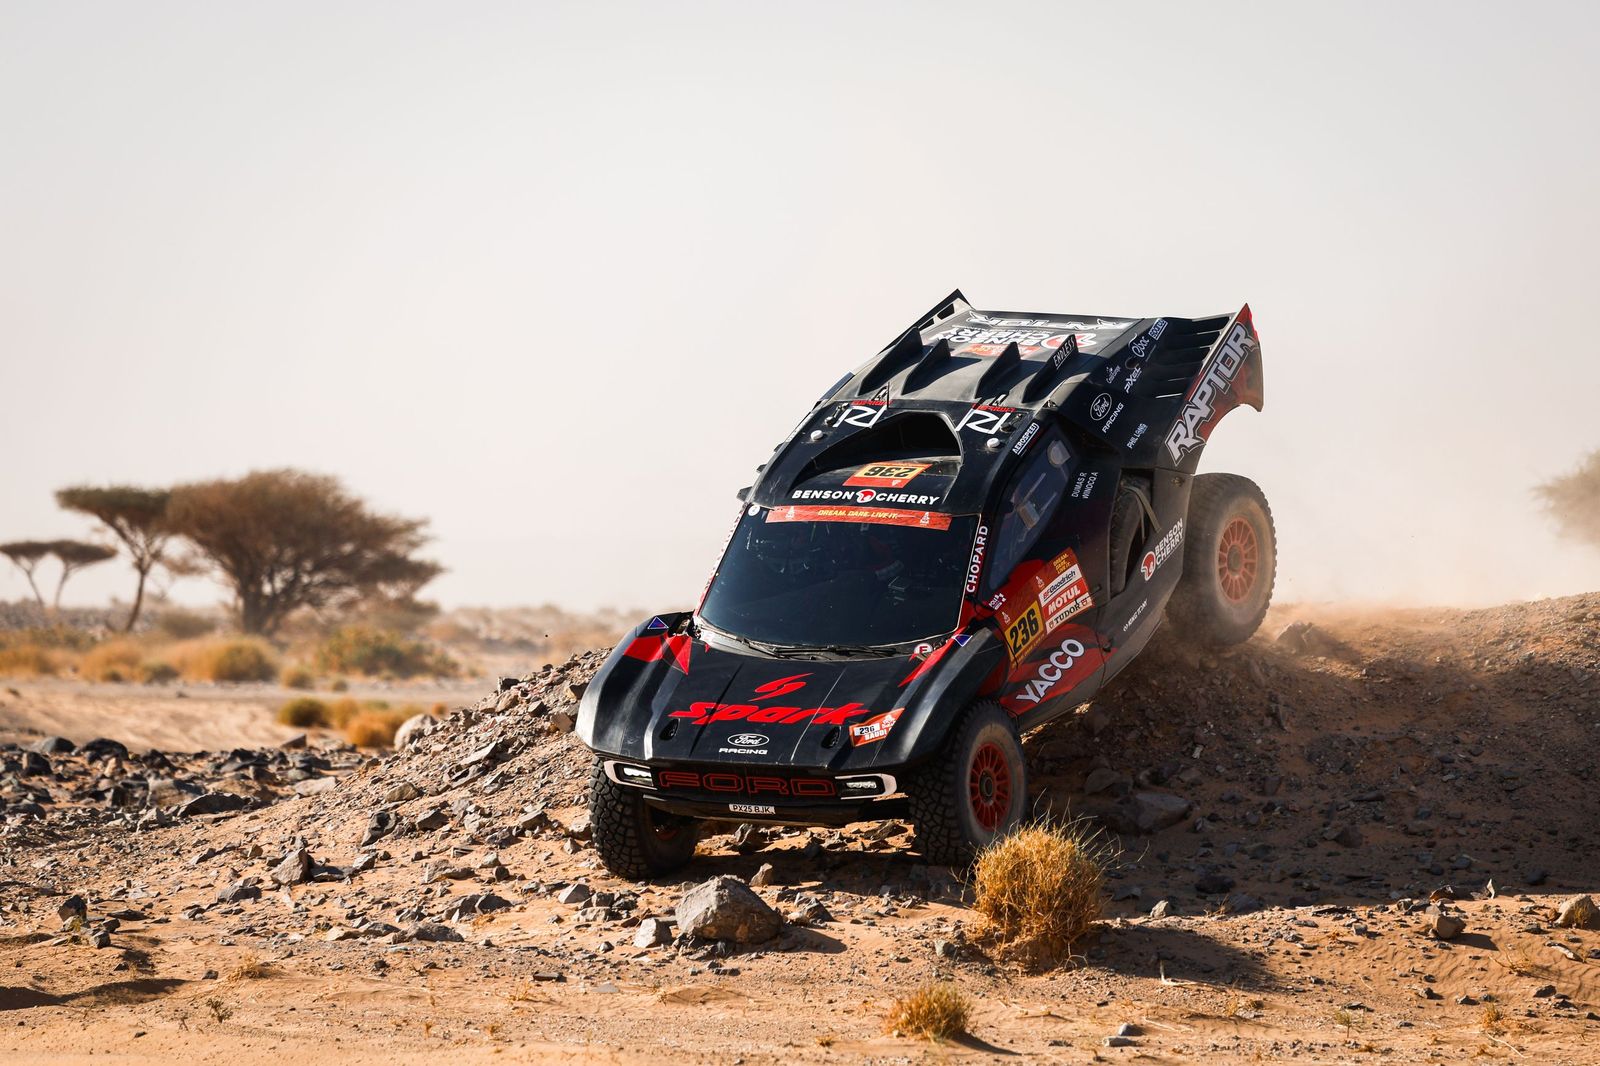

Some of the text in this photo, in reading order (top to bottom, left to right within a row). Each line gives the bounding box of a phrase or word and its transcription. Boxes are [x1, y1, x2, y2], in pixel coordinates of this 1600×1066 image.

[1053, 337, 1075, 367] ENDLESS
[1092, 395, 1110, 418] Ford
[1165, 322, 1258, 464] RAPTOR
[1102, 402, 1124, 433] RACING
[864, 466, 916, 478] 236
[792, 489, 939, 506] BENSON CHERRY
[1154, 518, 1183, 556] BENSON
[1156, 528, 1184, 565] CHERRY
[966, 525, 988, 593] CHOPARD
[1043, 570, 1076, 600] BFGoodrich
[1048, 584, 1081, 616] MOTUL
[1053, 602, 1081, 624] TUDOR
[1009, 608, 1040, 652] 236
[1015, 638, 1085, 704] YACCO
[668, 701, 871, 725] Spark
[732, 734, 765, 746] Ford
[860, 725, 875, 735] 236
[719, 747, 768, 755] RACING
[659, 771, 836, 797] FORD
[732, 805, 770, 814] PX25 BJK
